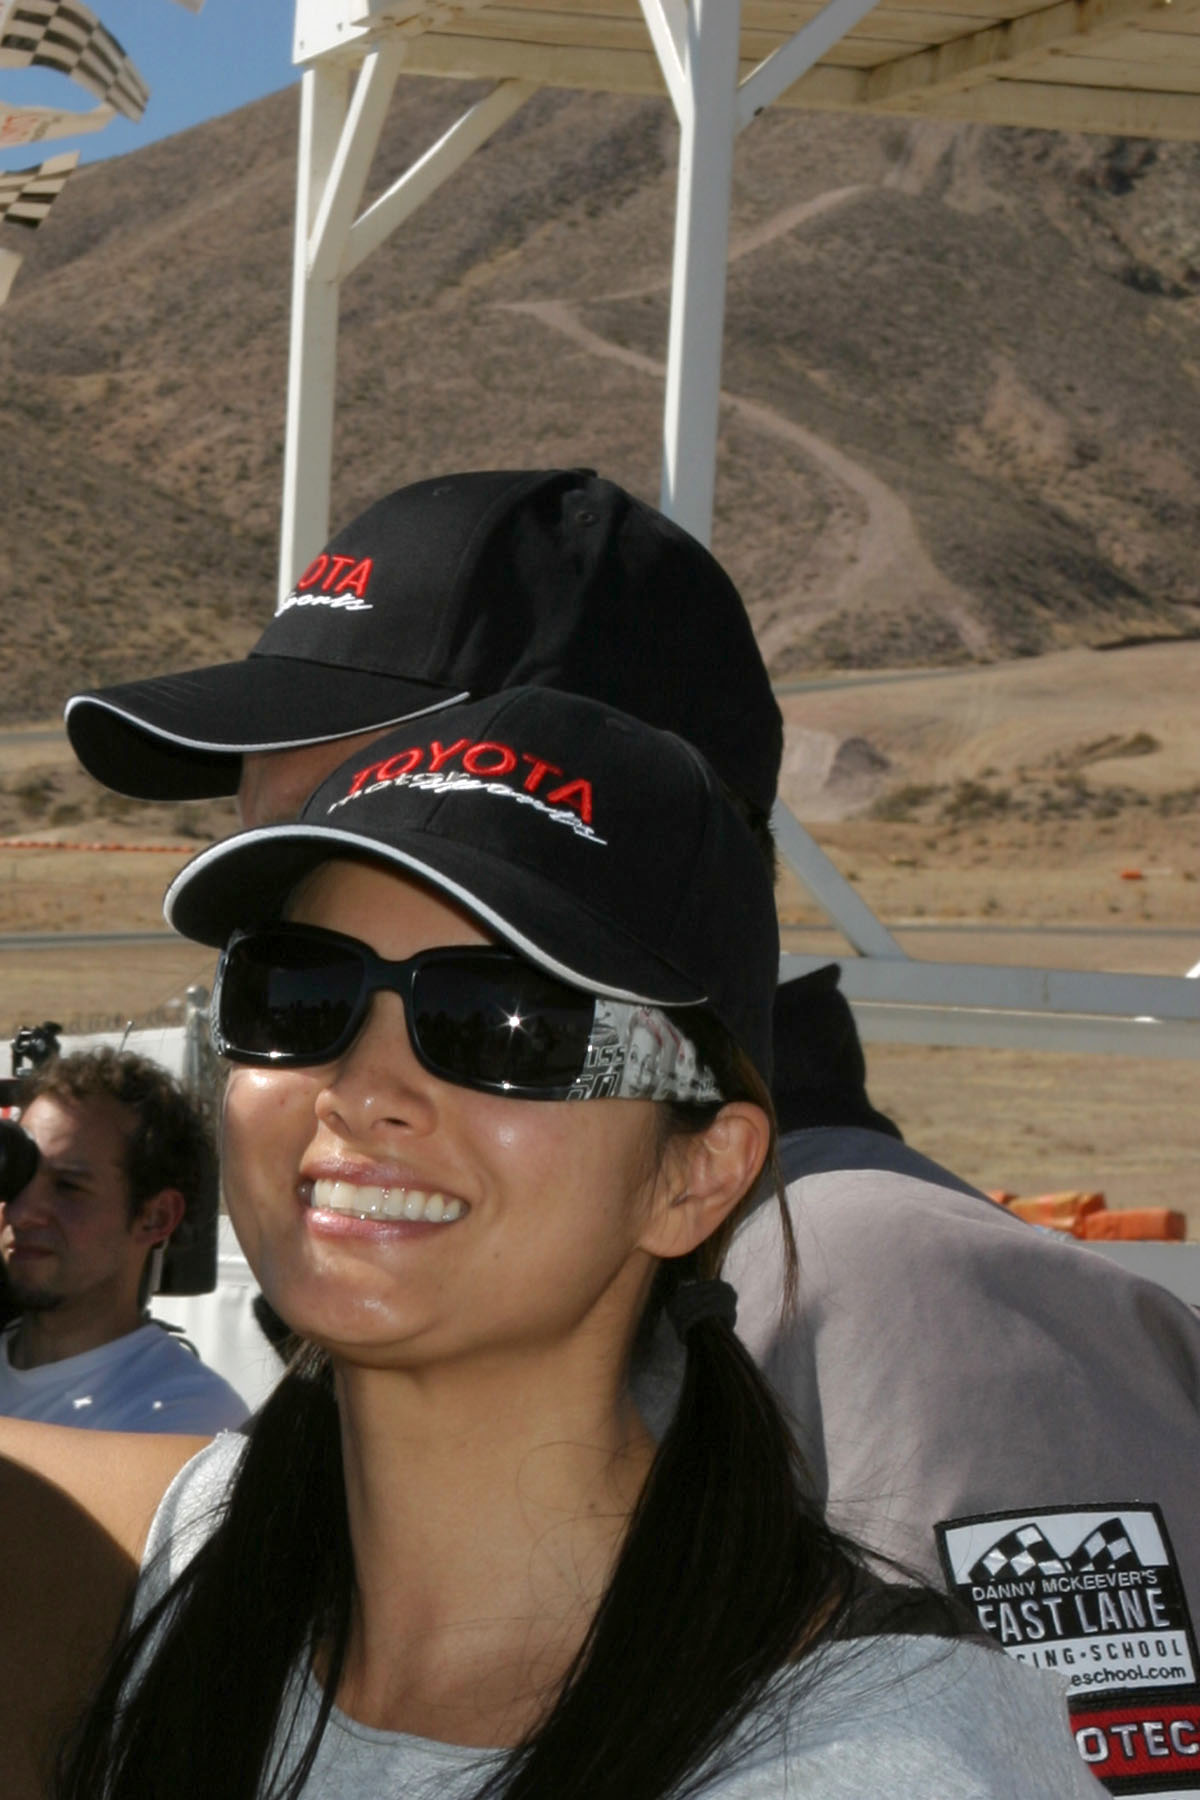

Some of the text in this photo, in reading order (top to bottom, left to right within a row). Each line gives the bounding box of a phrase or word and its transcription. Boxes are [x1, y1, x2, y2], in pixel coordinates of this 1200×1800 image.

[349, 739, 592, 825] TOYOTA
[972, 1569, 1158, 1602] DANNY MCKEEVER'S
[977, 1588, 1171, 1643] FAST LANE
